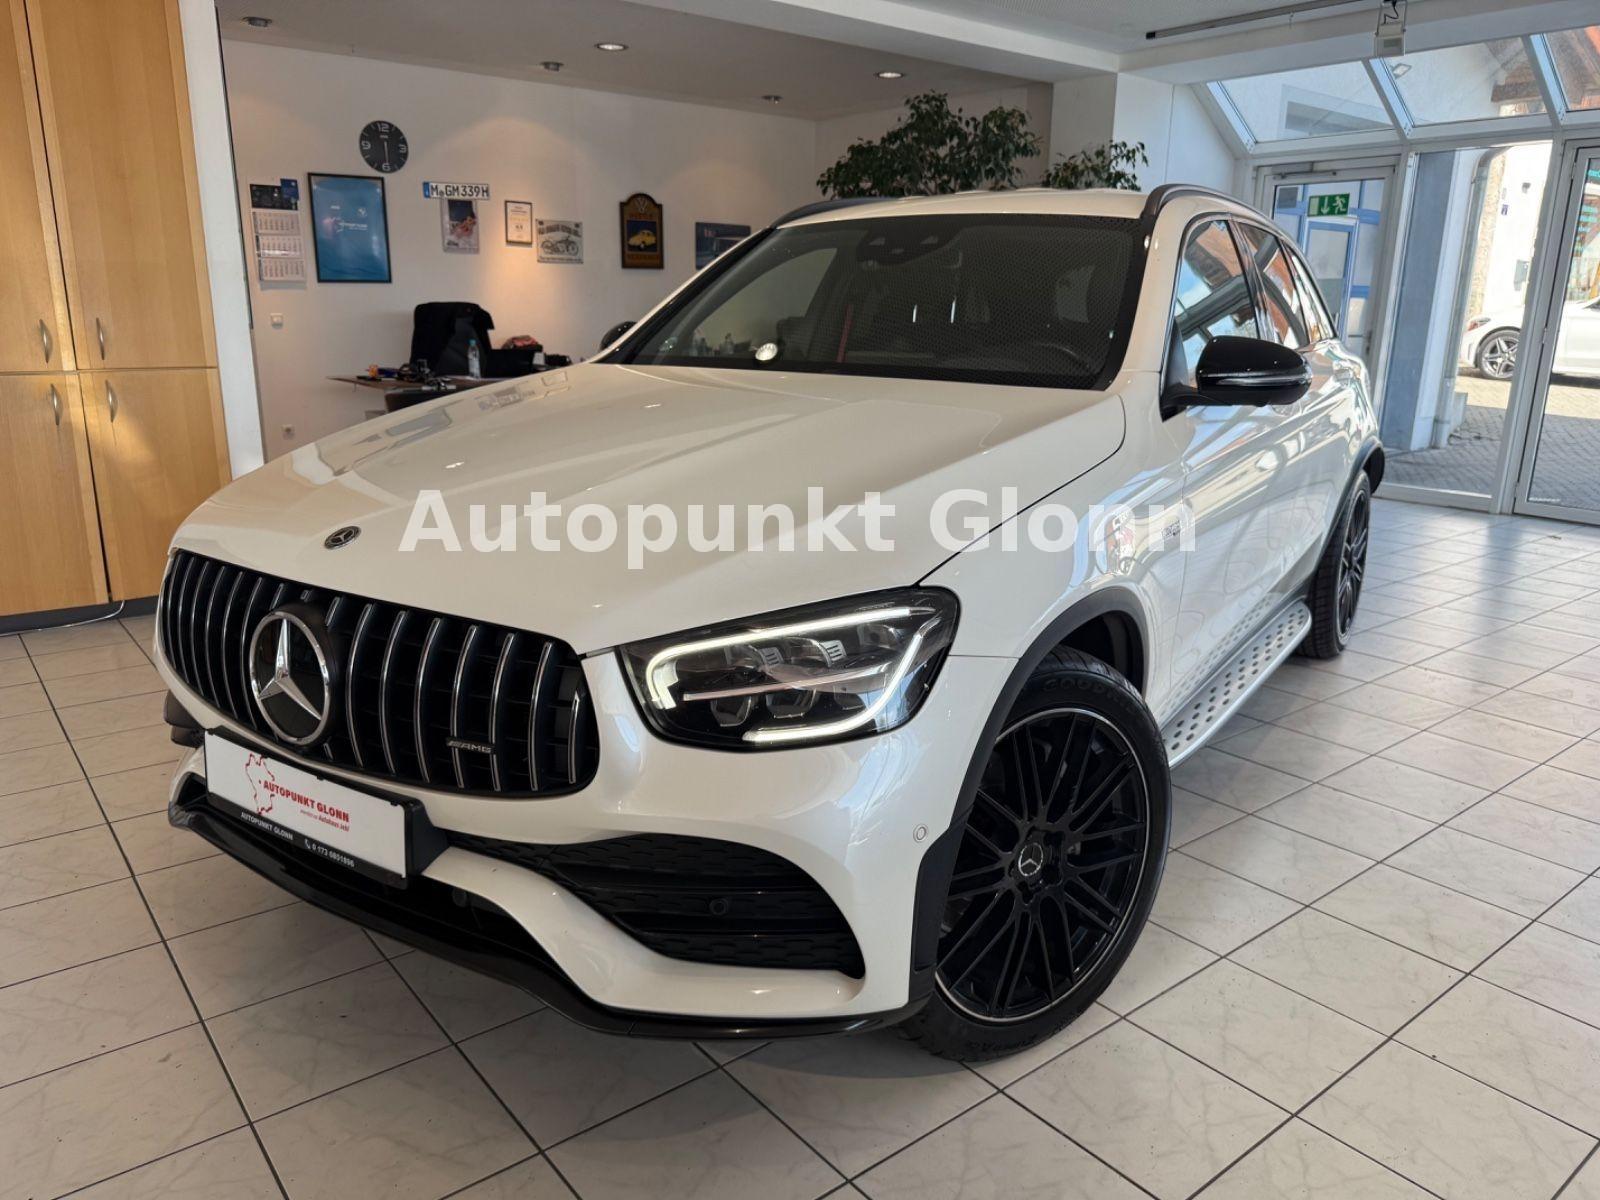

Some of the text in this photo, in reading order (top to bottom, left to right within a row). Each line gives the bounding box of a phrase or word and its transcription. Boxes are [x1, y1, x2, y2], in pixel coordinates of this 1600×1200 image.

[377, 122, 390, 133] 12
[361, 140, 371, 150] 9
[382, 162, 391, 171] 6
[460, 742, 491, 753] AMG
[263, 780, 315, 809] AUTOPUNKT
[317, 802, 349, 822] GLONN
[241, 812, 294, 841] AUTOPUNKT GLONN
